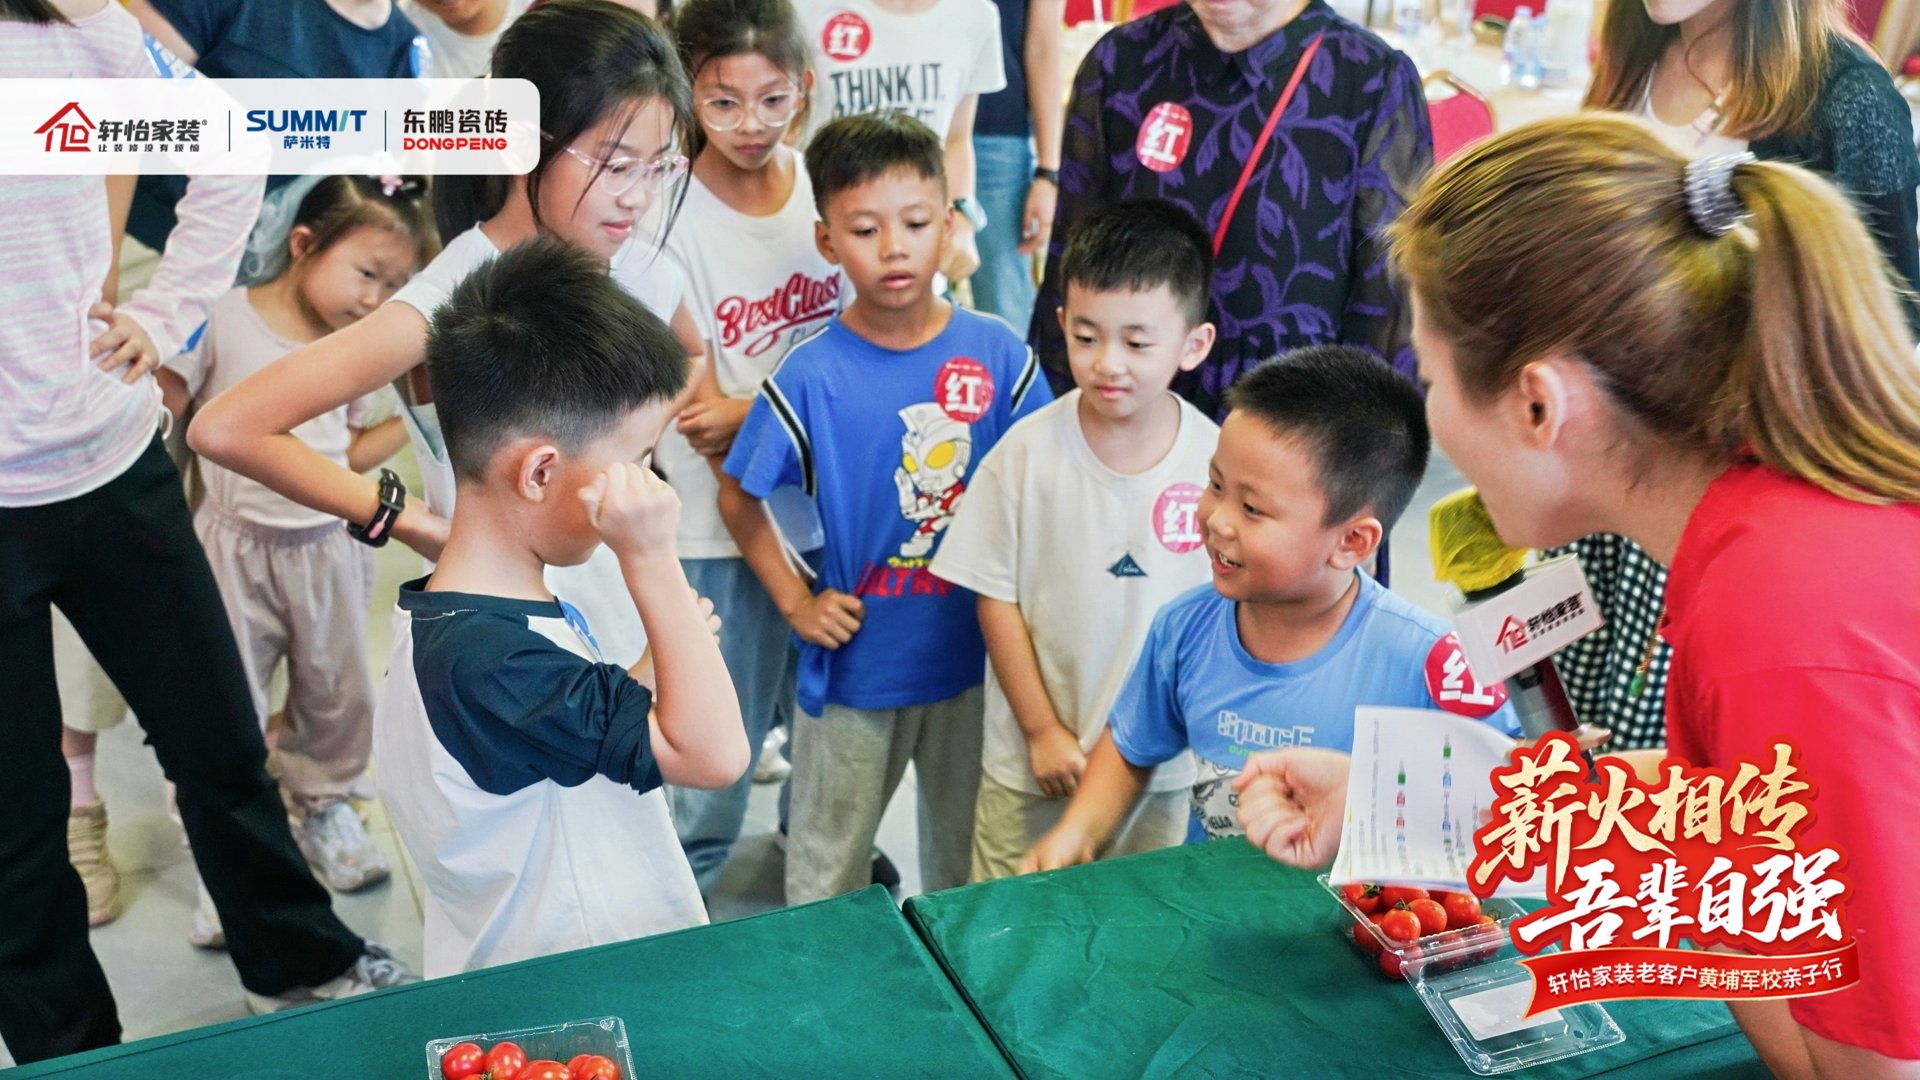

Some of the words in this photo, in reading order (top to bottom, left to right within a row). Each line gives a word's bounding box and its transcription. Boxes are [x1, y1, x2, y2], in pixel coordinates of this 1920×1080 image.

[829, 65, 912, 106] THINK
[1141, 118, 1185, 164] 红
[944, 371, 983, 414] 红
[1162, 499, 1202, 544] 红
